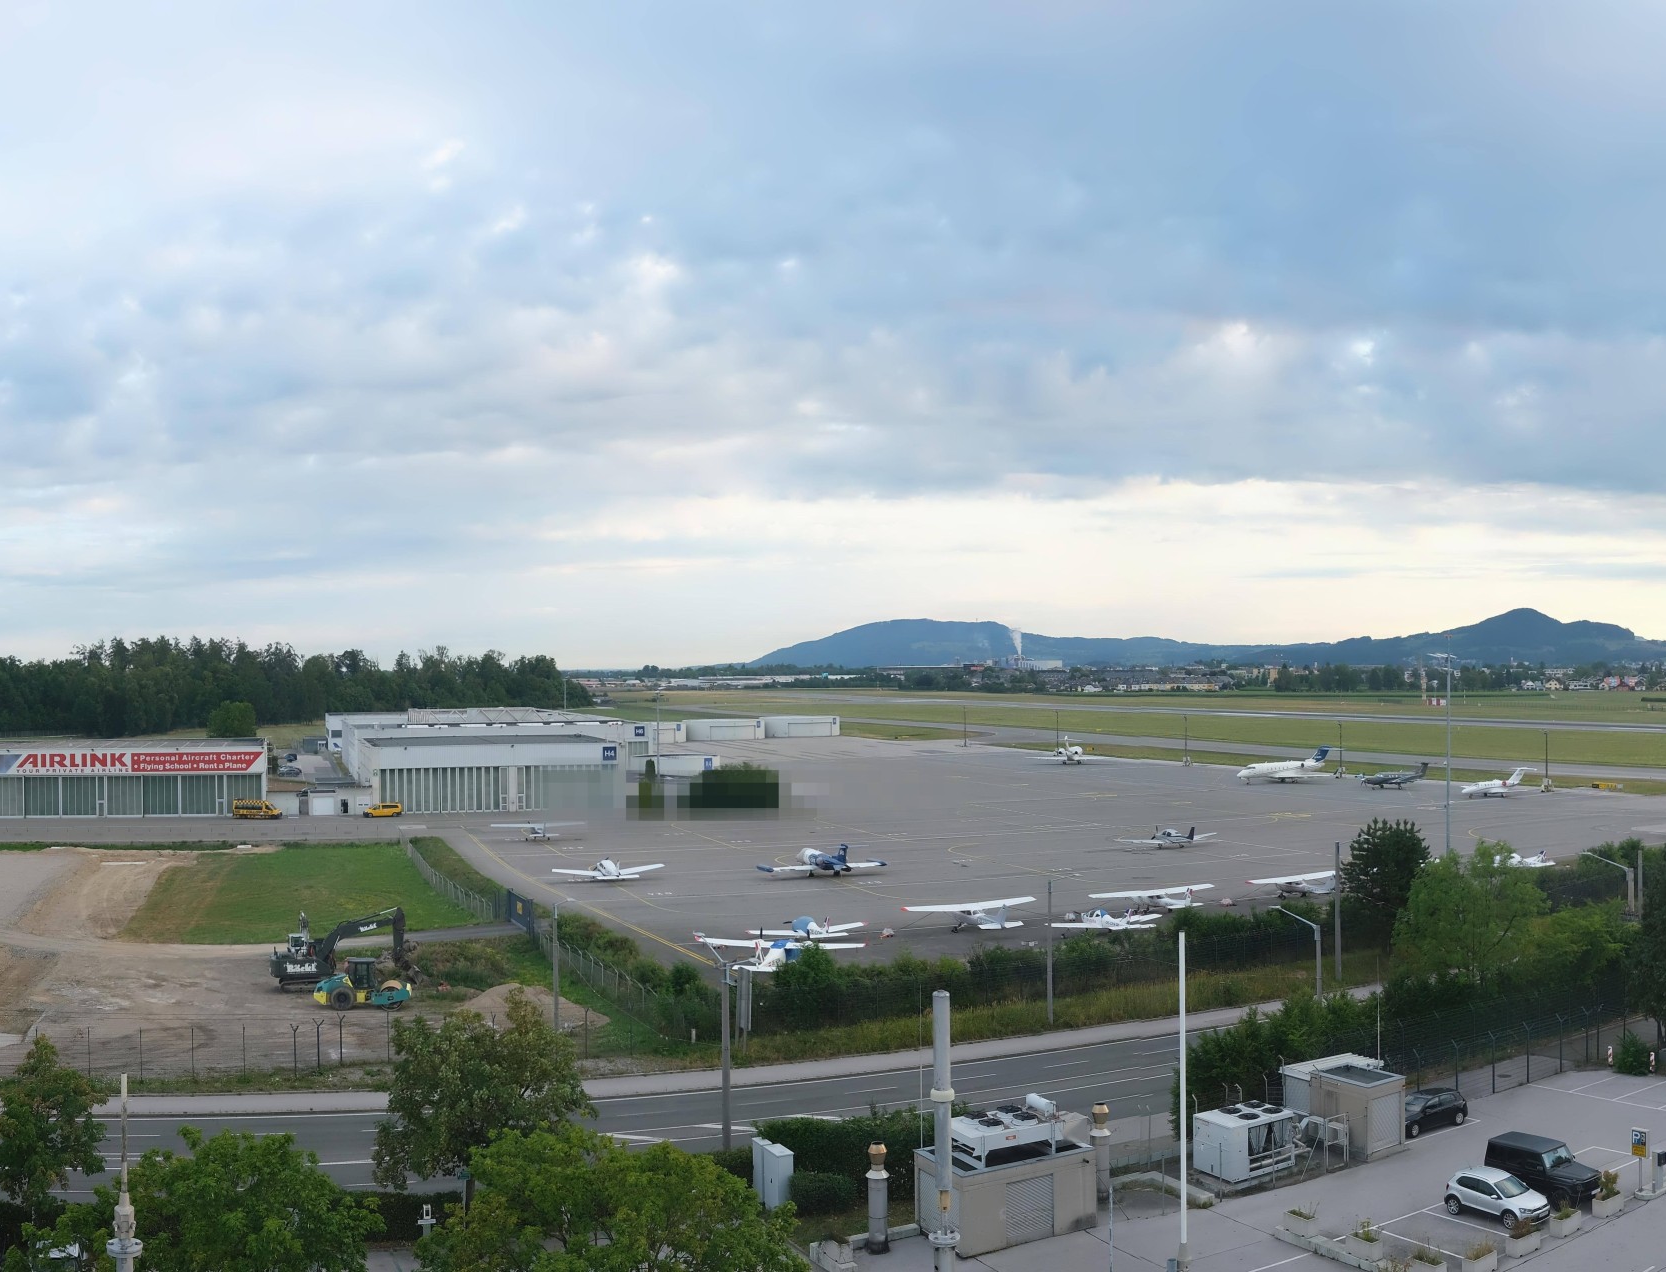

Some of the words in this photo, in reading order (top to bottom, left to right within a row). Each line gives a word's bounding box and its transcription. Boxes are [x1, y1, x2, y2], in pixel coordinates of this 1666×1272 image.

[604, 749, 615, 757] H4
[16, 752, 128, 768] AIRLINK
[1632, 1131, 1641, 1144] P
